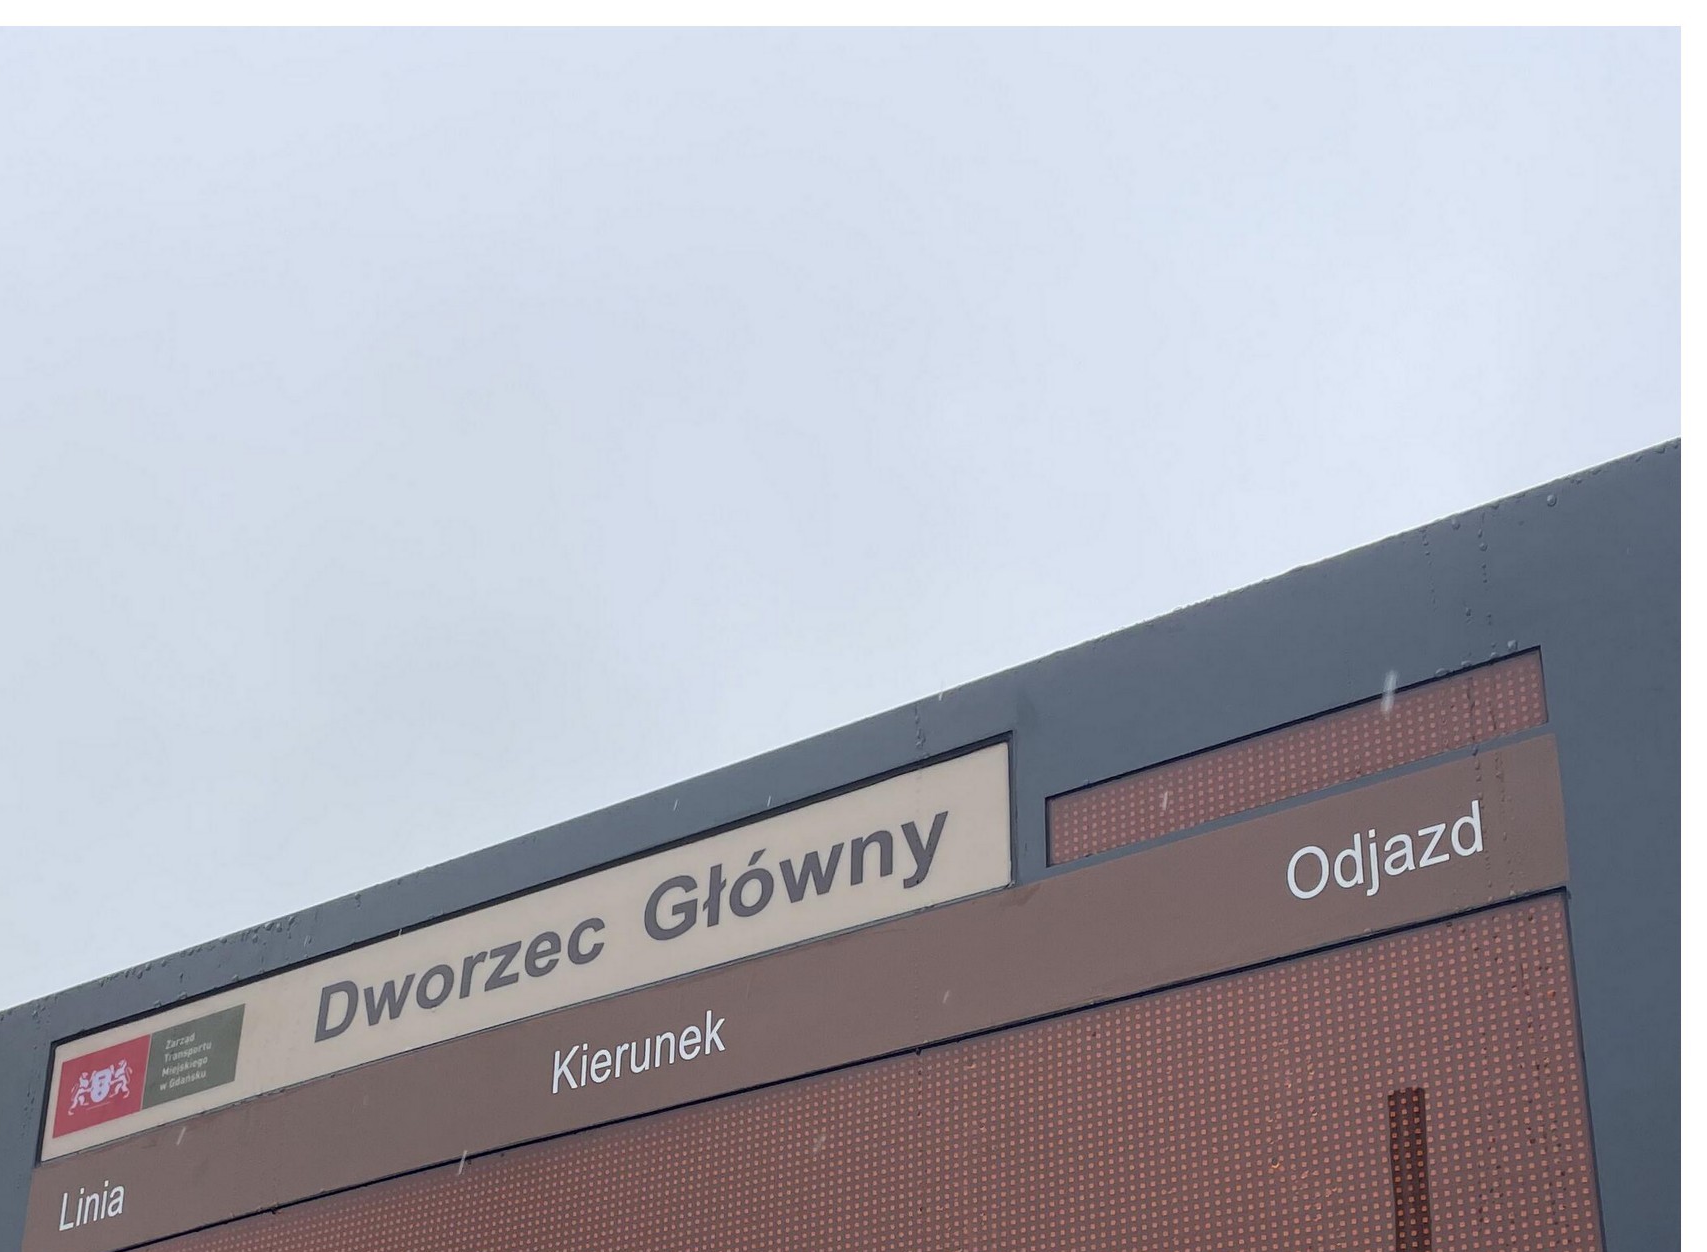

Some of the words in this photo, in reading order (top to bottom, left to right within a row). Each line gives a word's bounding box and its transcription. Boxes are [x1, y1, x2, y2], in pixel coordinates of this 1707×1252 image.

[1287, 799, 1484, 899] Odjazd
[314, 915, 606, 1044] Dworzec
[643, 811, 949, 942] Główny
[161, 1055, 209, 1078] Miejskiego
[164, 1040, 212, 1063] Transportu
[551, 1009, 727, 1095] Kierunek
[58, 1180, 125, 1232] Linia
